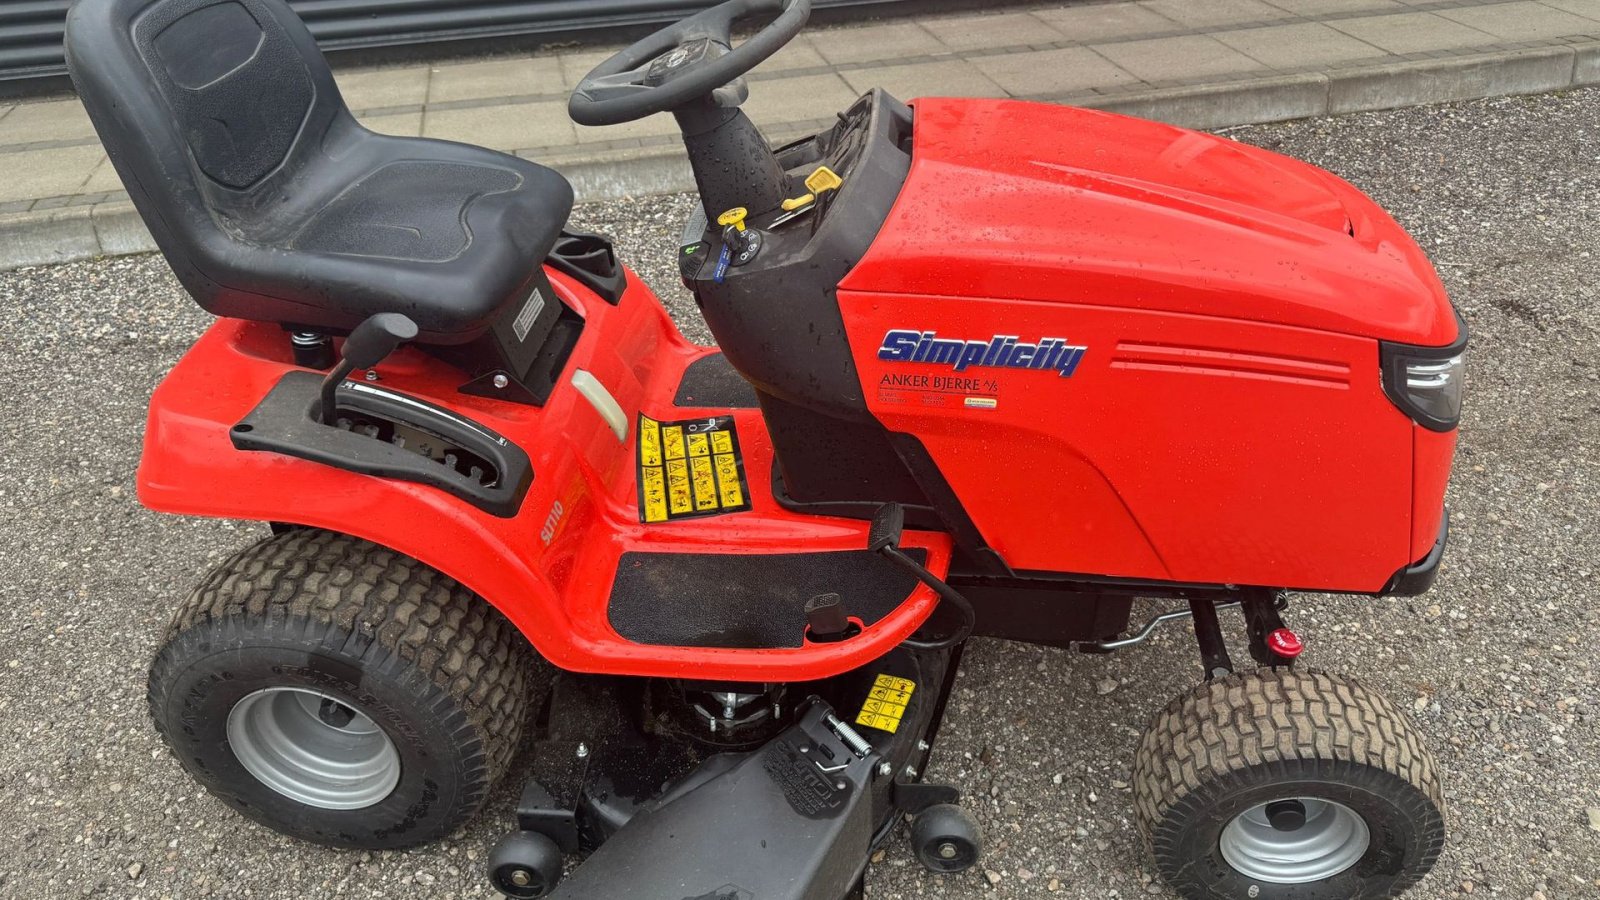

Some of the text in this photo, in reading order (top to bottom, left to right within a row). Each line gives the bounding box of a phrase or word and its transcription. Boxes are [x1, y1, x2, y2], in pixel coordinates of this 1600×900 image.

[878, 329, 1088, 377] Simplicity
[880, 374, 929, 388] ANKER
[933, 375, 980, 391] BJERRE
